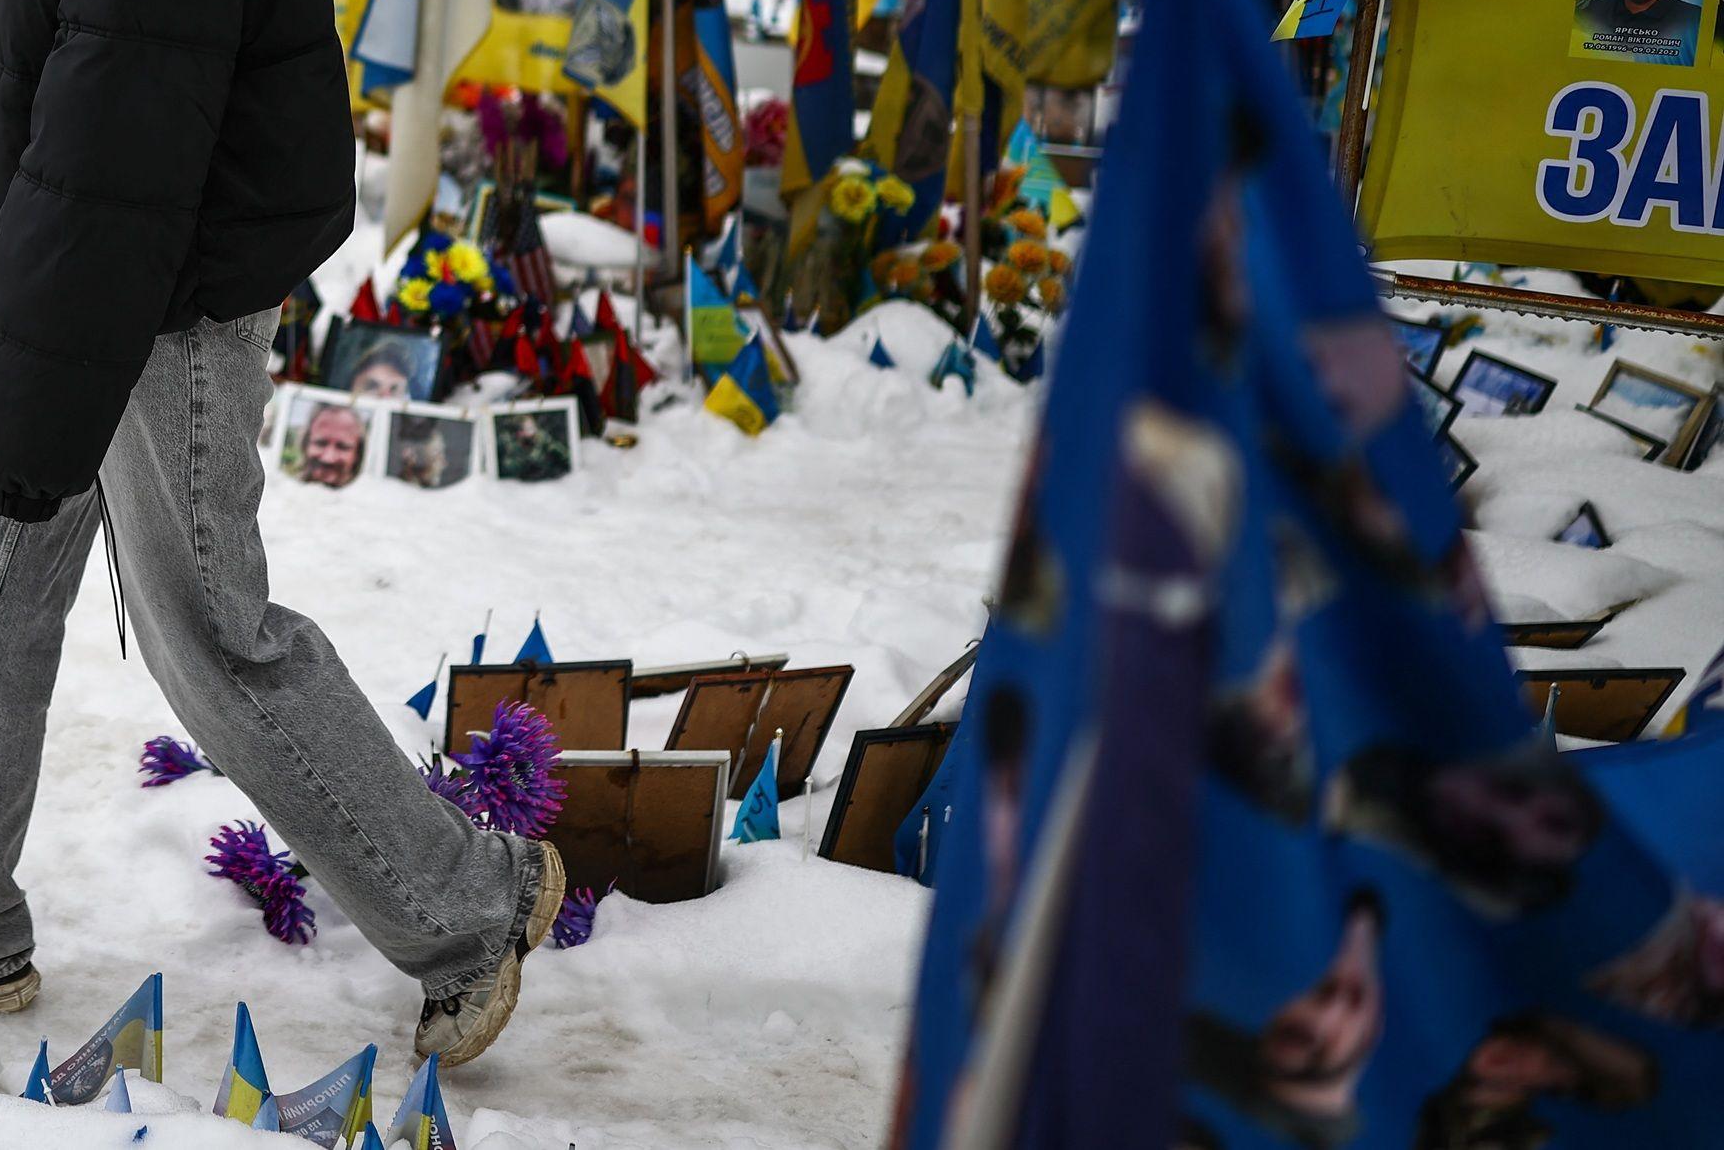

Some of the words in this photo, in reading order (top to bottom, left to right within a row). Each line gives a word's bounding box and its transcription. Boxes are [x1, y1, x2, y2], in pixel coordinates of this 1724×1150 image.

[1614, 27, 1659, 37] ЯРЕСЬКО
[1593, 33, 1625, 43] РОМАН
[1627, 36, 1682, 47] ВІКТОРОВИЧ
[1535, 80, 1724, 236] ЗА
